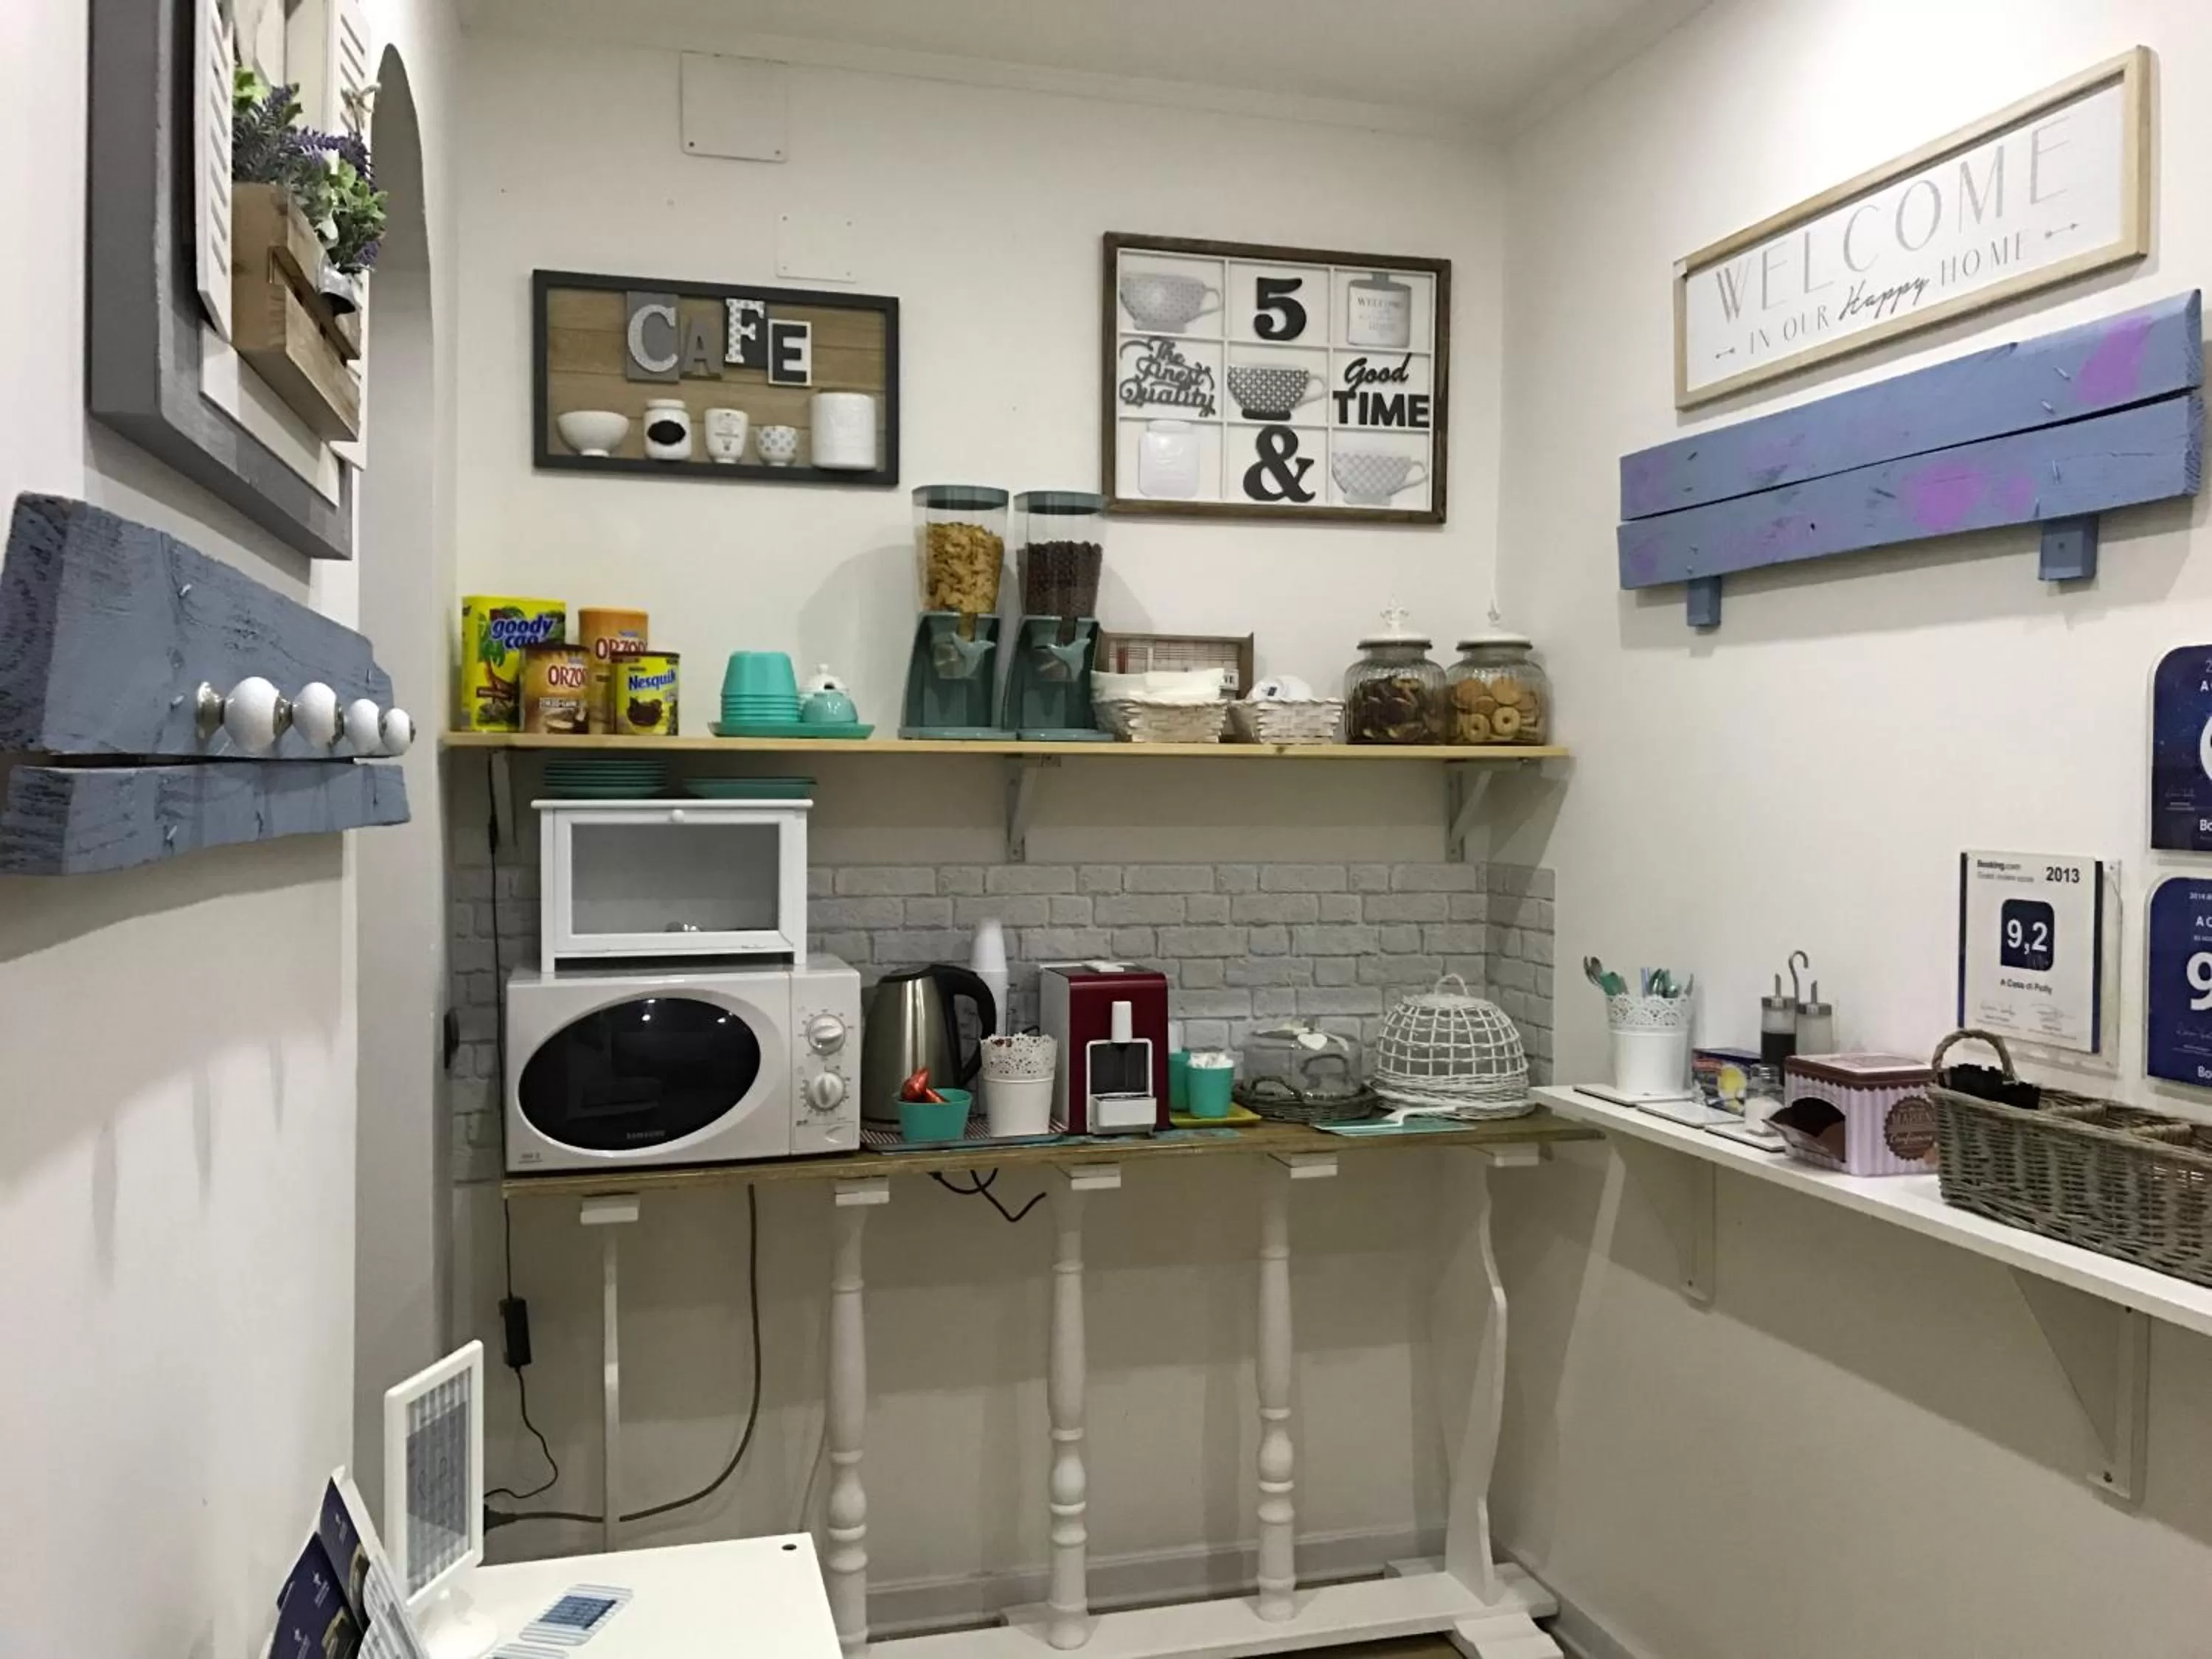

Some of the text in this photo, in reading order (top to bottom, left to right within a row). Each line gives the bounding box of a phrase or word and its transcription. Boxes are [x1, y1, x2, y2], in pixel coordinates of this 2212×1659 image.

[1716, 115, 2070, 324] WELCOME
[1253, 276, 1307, 341] 5
[1749, 230, 2028, 355] IN OUR Happy HOME
[627, 298, 808, 383] CAFE
[1120, 335, 1186, 364] The
[1343, 352, 1413, 394] Good
[1119, 375, 1216, 417] Quality
[1332, 389, 1430, 428] TIME
[492, 614, 554, 640] goody
[628, 669, 675, 690] Nesquik
[2045, 866, 2081, 884] 2013
[2006, 919, 2048, 955] 9,2
